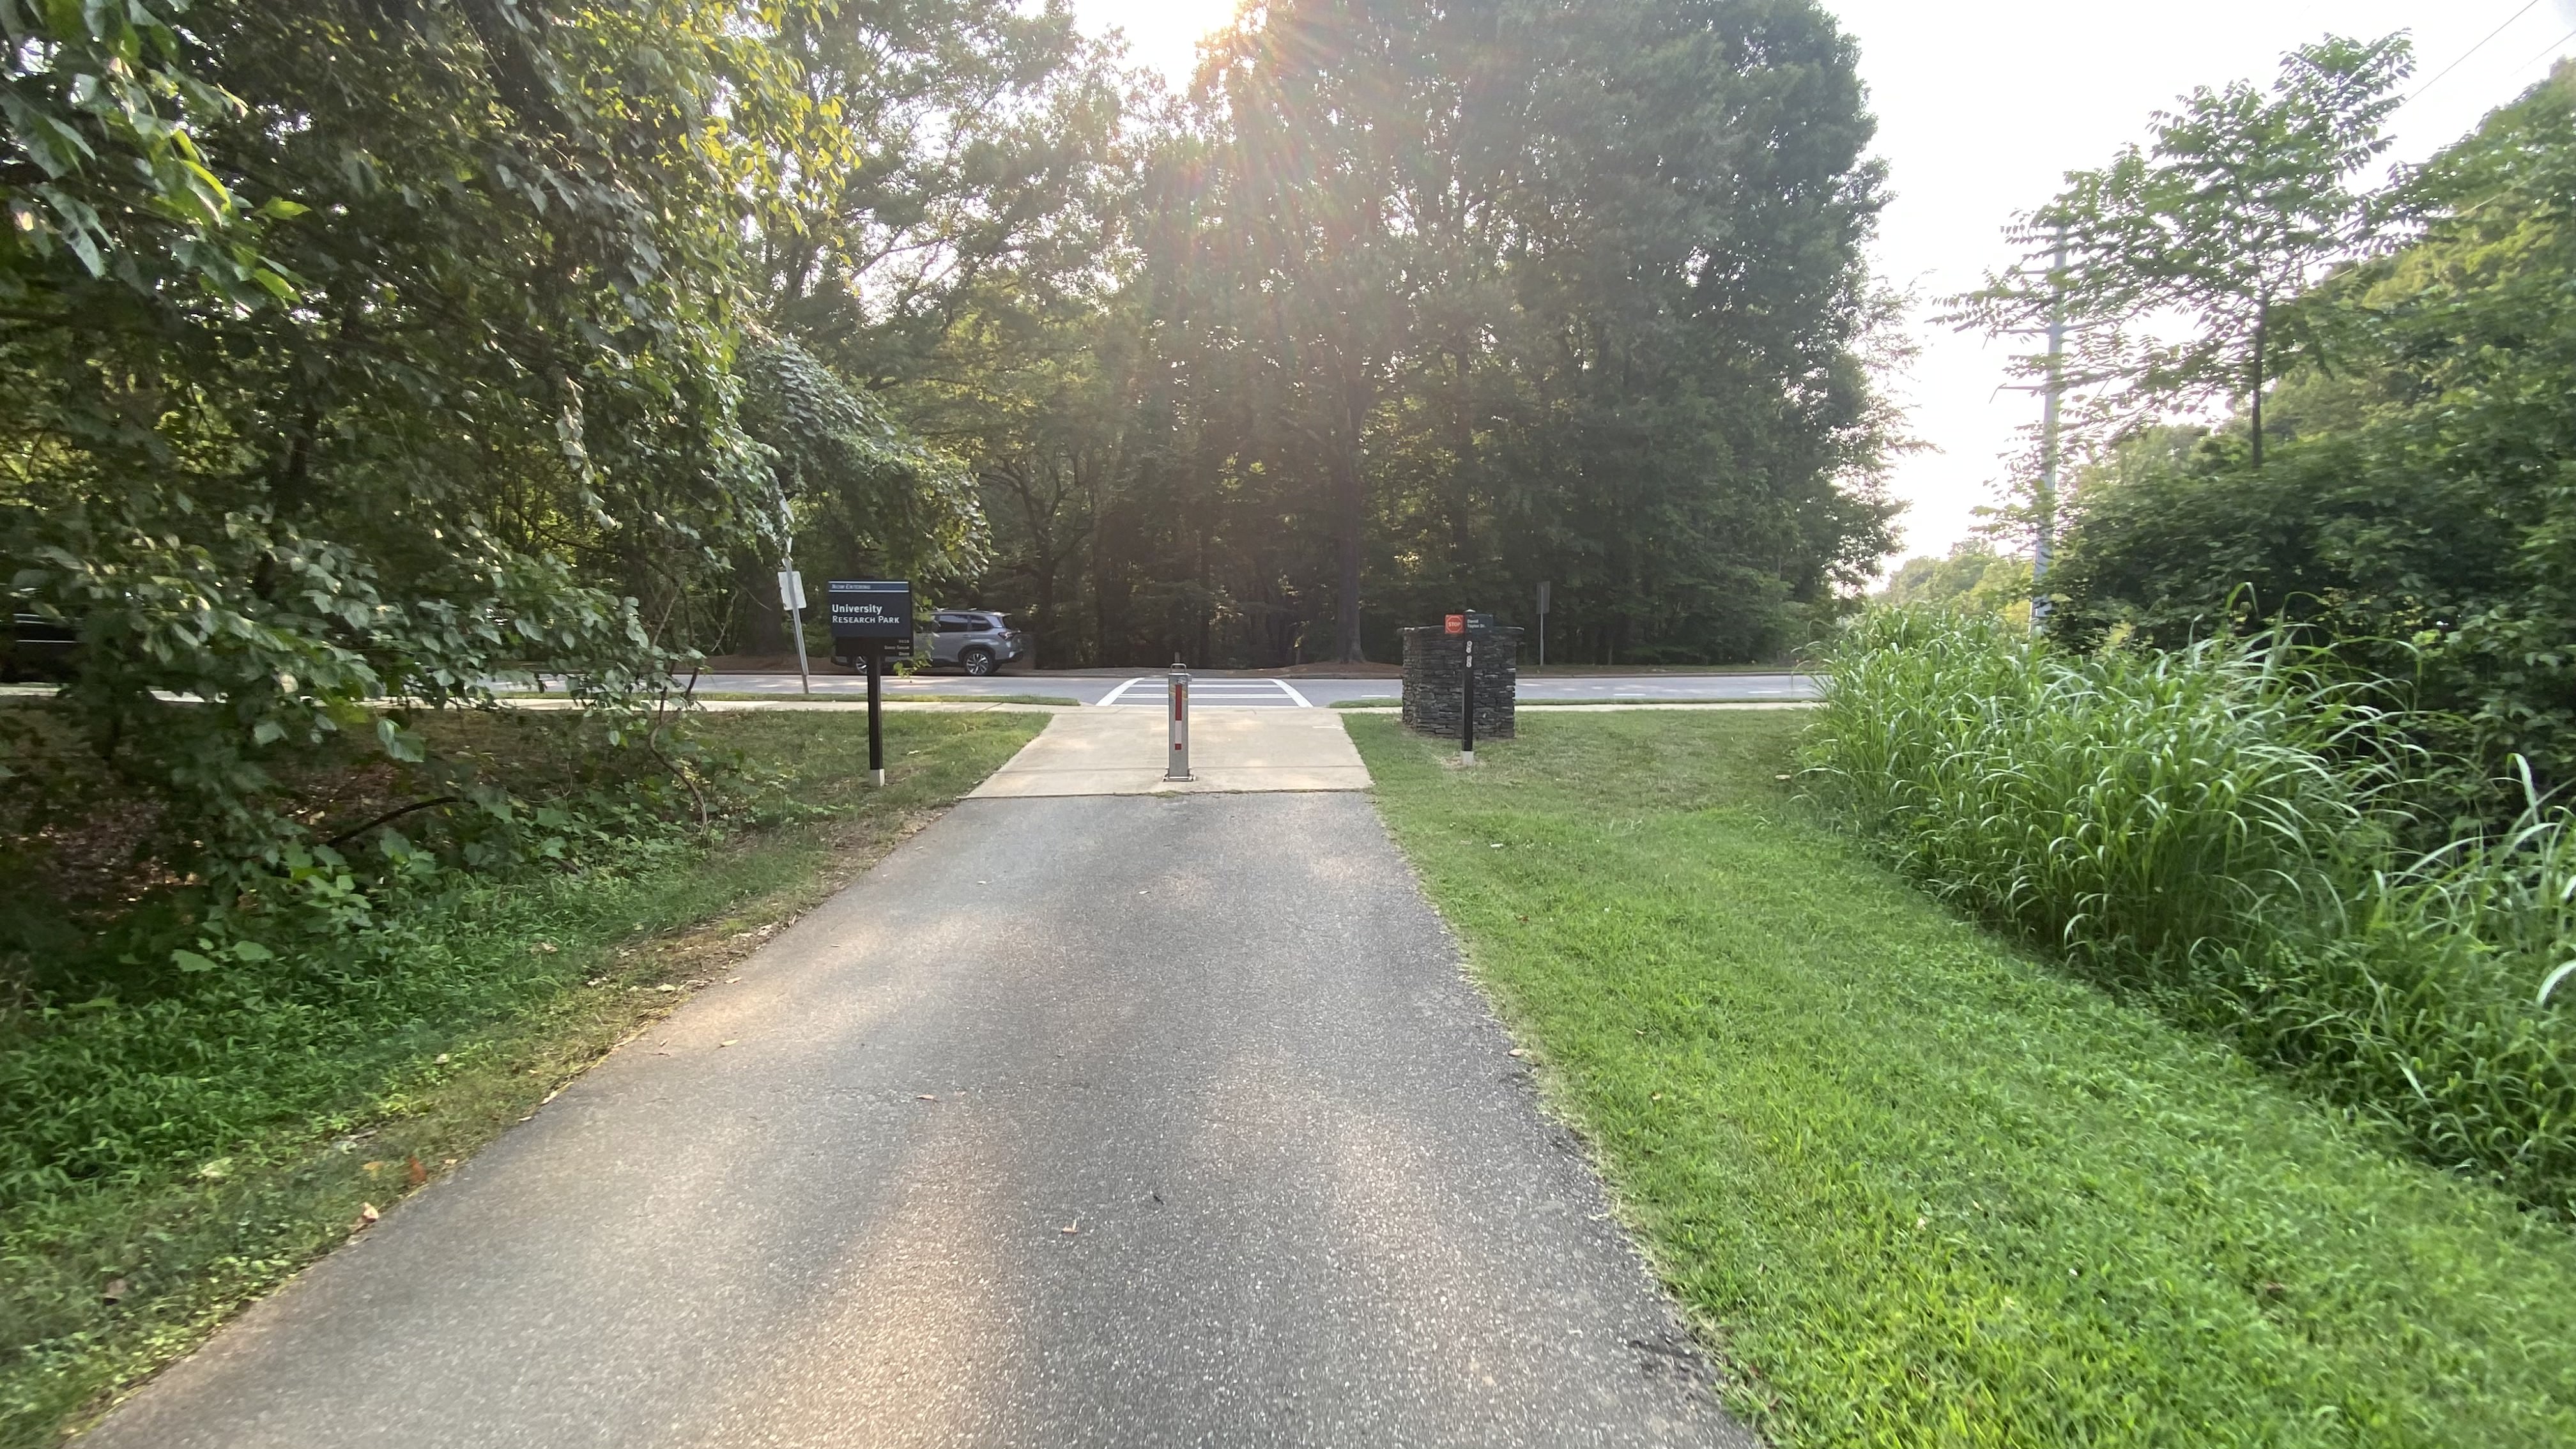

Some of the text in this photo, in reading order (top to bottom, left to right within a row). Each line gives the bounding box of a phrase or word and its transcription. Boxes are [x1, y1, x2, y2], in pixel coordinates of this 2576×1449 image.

[832, 604, 882, 615] University
[832, 615, 900, 624] RESEARCH PARK
